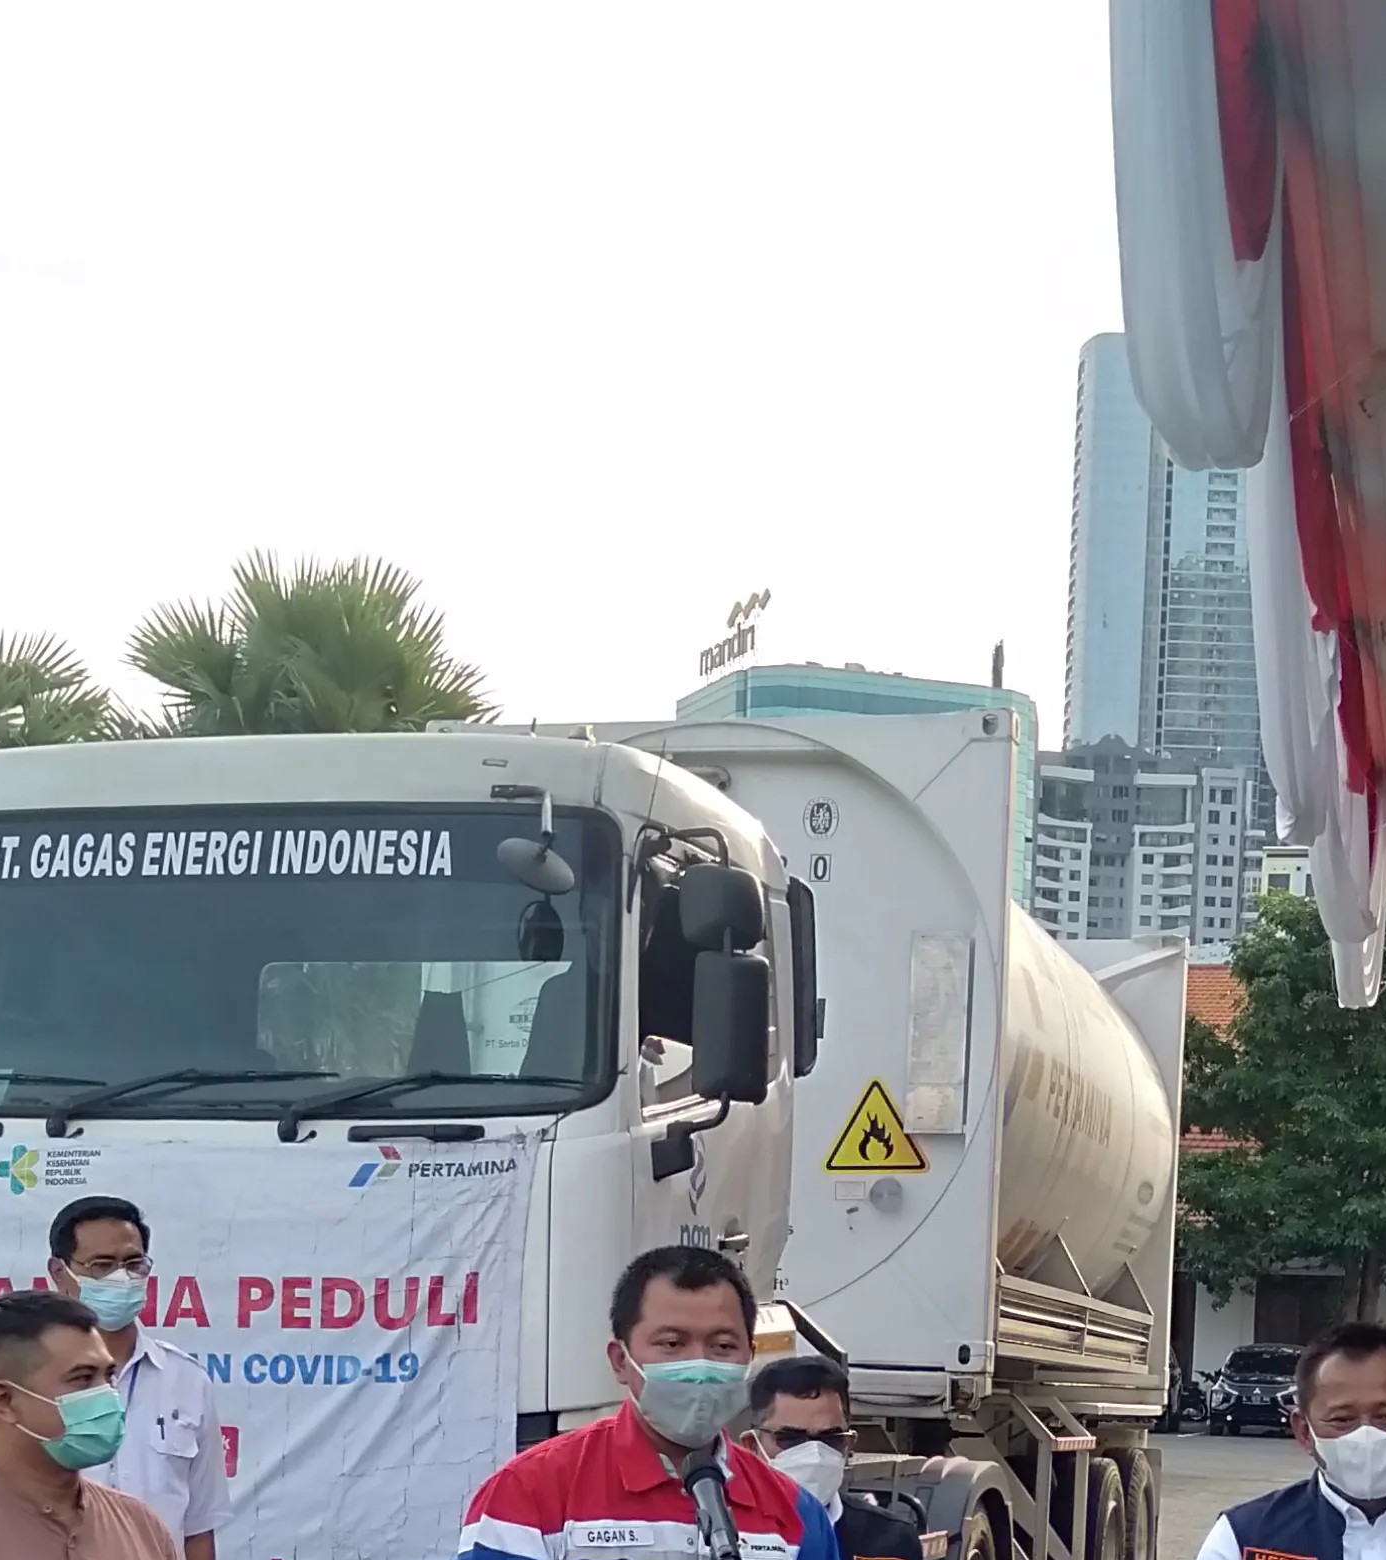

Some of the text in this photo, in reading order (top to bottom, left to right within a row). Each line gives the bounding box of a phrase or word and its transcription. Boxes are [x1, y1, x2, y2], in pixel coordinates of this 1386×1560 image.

[30, 832, 136, 879] GAGAS
[141, 830, 263, 877] ENERGI
[269, 829, 452, 876] INDONESIA
[46, 1149, 101, 1158] KEMENTERIAN
[46, 1159, 90, 1168] KESEHATAN
[408, 1158, 518, 1178] PERTAMINA
[45, 1168, 82, 1176] REPUBLIK
[44, 1177, 88, 1186] INDONESIA
[237, 1271, 480, 1331] PEDULI
[243, 1352, 420, 1385] COVID-19
[587, 1530, 638, 1543] GAGAN S.
